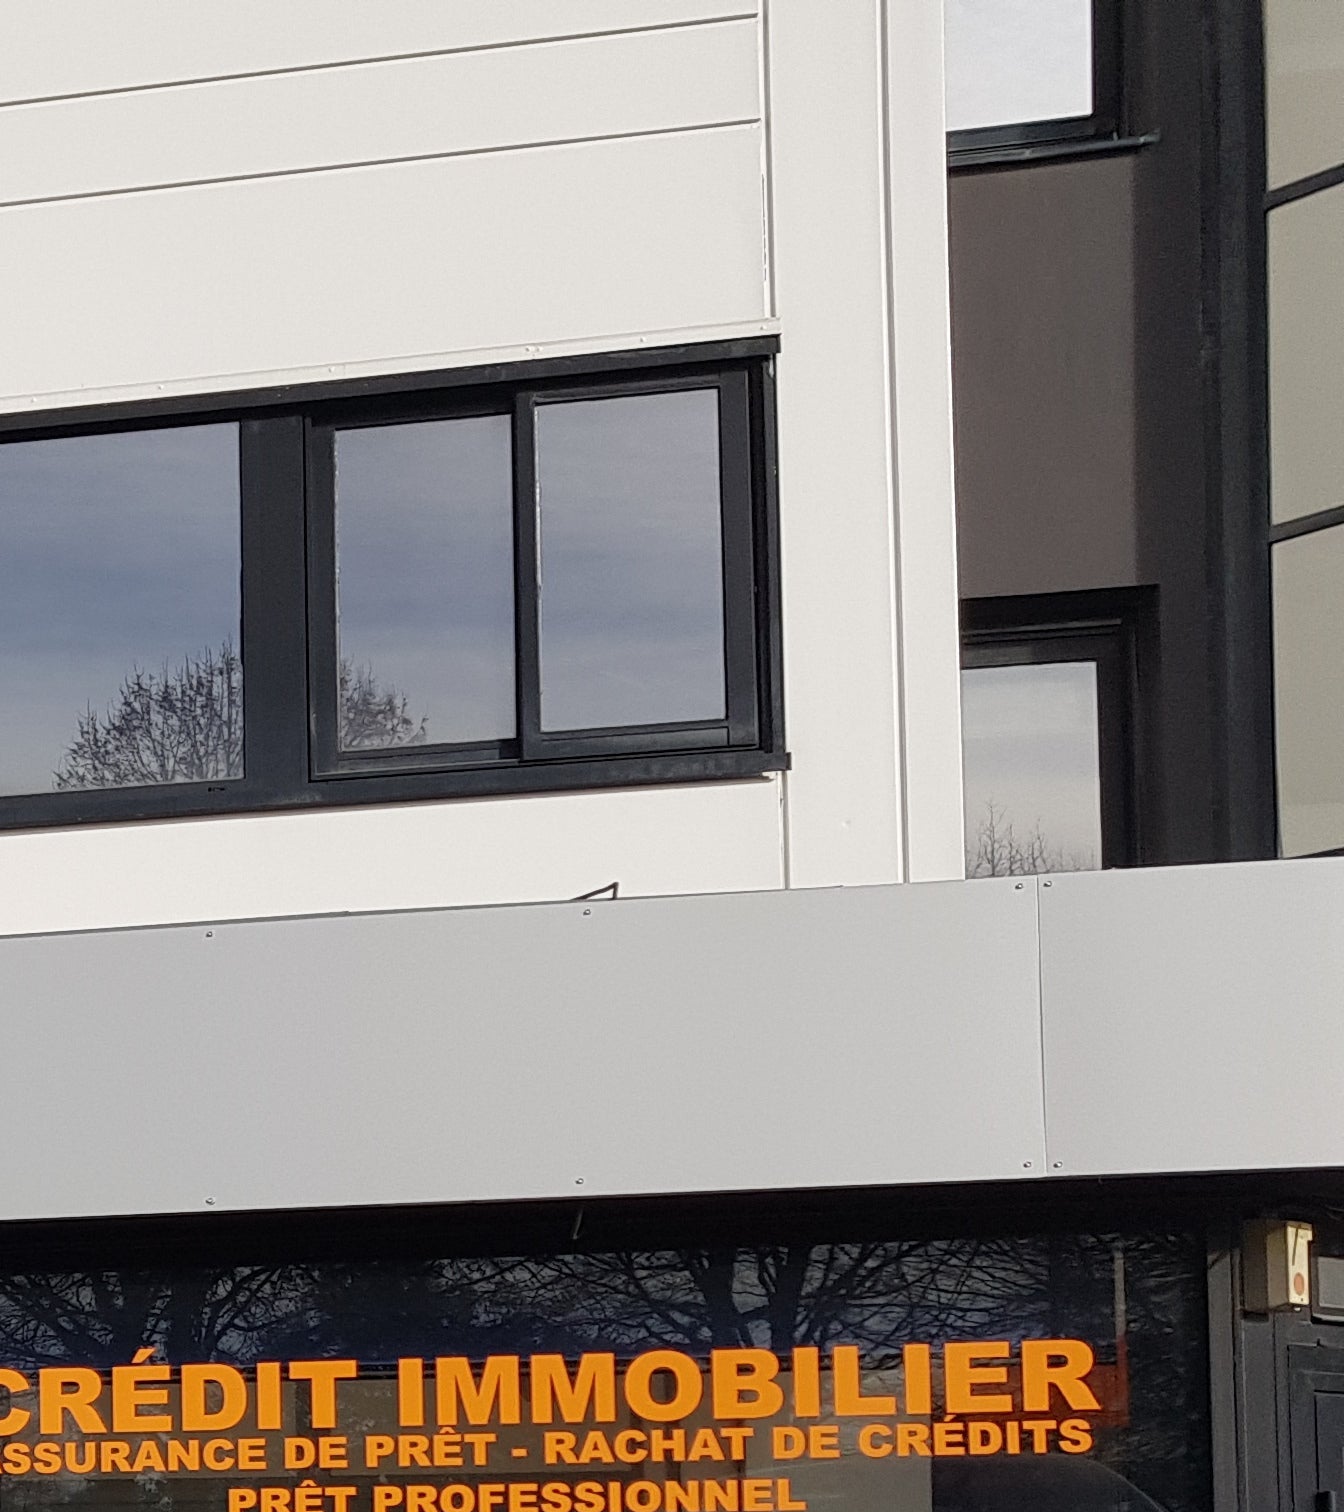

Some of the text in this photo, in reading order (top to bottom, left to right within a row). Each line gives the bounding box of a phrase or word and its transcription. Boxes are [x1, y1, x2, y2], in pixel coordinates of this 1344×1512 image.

[397, 1338, 1102, 1428] IMMOBILIER
[283, 1436, 349, 1470] DE
[364, 1426, 498, 1469] PRÊT
[543, 1427, 754, 1465] RACHAT
[771, 1425, 841, 1461] DE
[857, 1414, 1094, 1458] CRÉDITS
